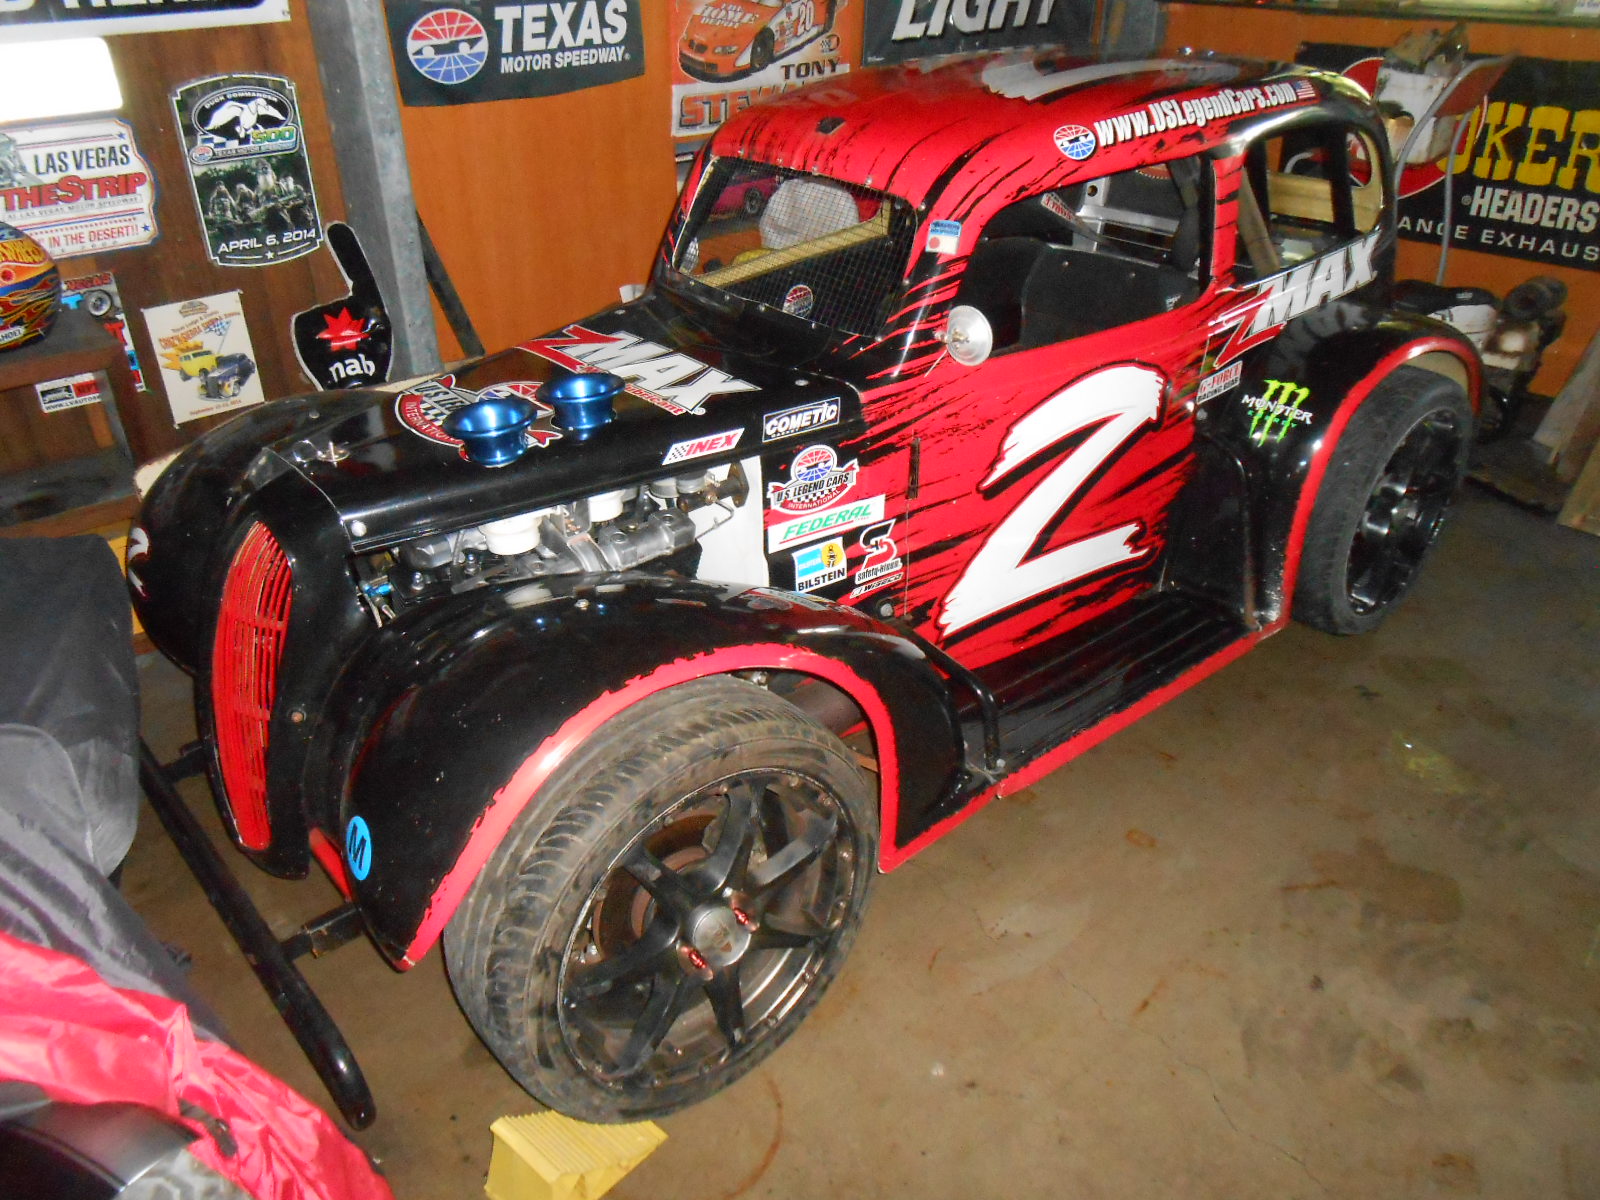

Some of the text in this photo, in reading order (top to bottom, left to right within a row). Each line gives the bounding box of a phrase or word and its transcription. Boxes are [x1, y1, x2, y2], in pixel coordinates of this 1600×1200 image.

[494, 0, 628, 54] TEXAS
[501, 46, 625, 74] MOTOR SPEEDWAY
[780, 58, 841, 80] TONY
[251, 125, 297, 145] 500
[33, 143, 131, 176] LAS VEGAS
[1469, 185, 1600, 234] HEADERS
[48, 235, 61, 249] IN
[64, 231, 87, 246] THE
[217, 228, 316, 254] APRIL 6, 2014
[1480, 228, 1600, 261] EXHAUS
[328, 353, 376, 383] nab
[765, 402, 838, 436] COMETIC
[1241, 394, 1313, 425] MONSTER
[686, 432, 739, 457] INEX
[793, 479, 825, 497] LEGEND
[826, 472, 850, 488] CARS
[787, 489, 841, 509] INTERNATIONAL
[783, 504, 872, 540] FEDERAL
[797, 567, 846, 592] BILSTEIN
